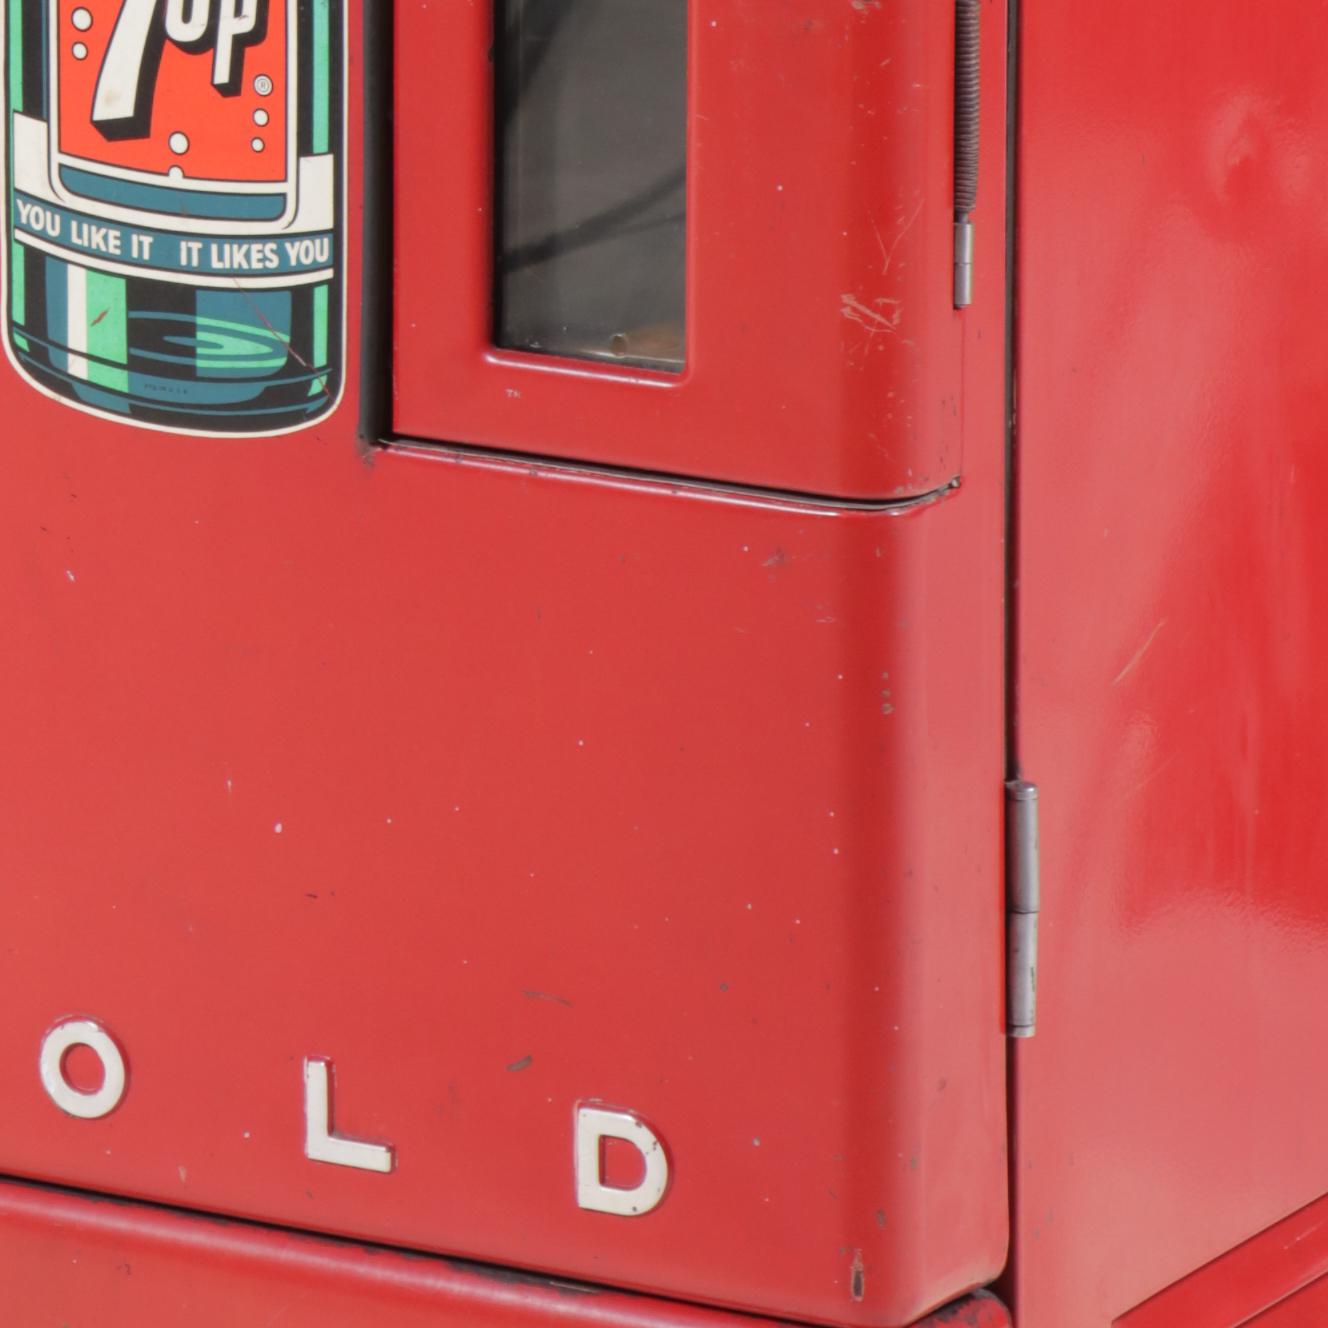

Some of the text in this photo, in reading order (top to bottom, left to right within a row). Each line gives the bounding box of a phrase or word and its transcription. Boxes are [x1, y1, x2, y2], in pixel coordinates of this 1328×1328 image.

[16, 198, 330, 269] YOU LIKE IT IT LIKES YOU
